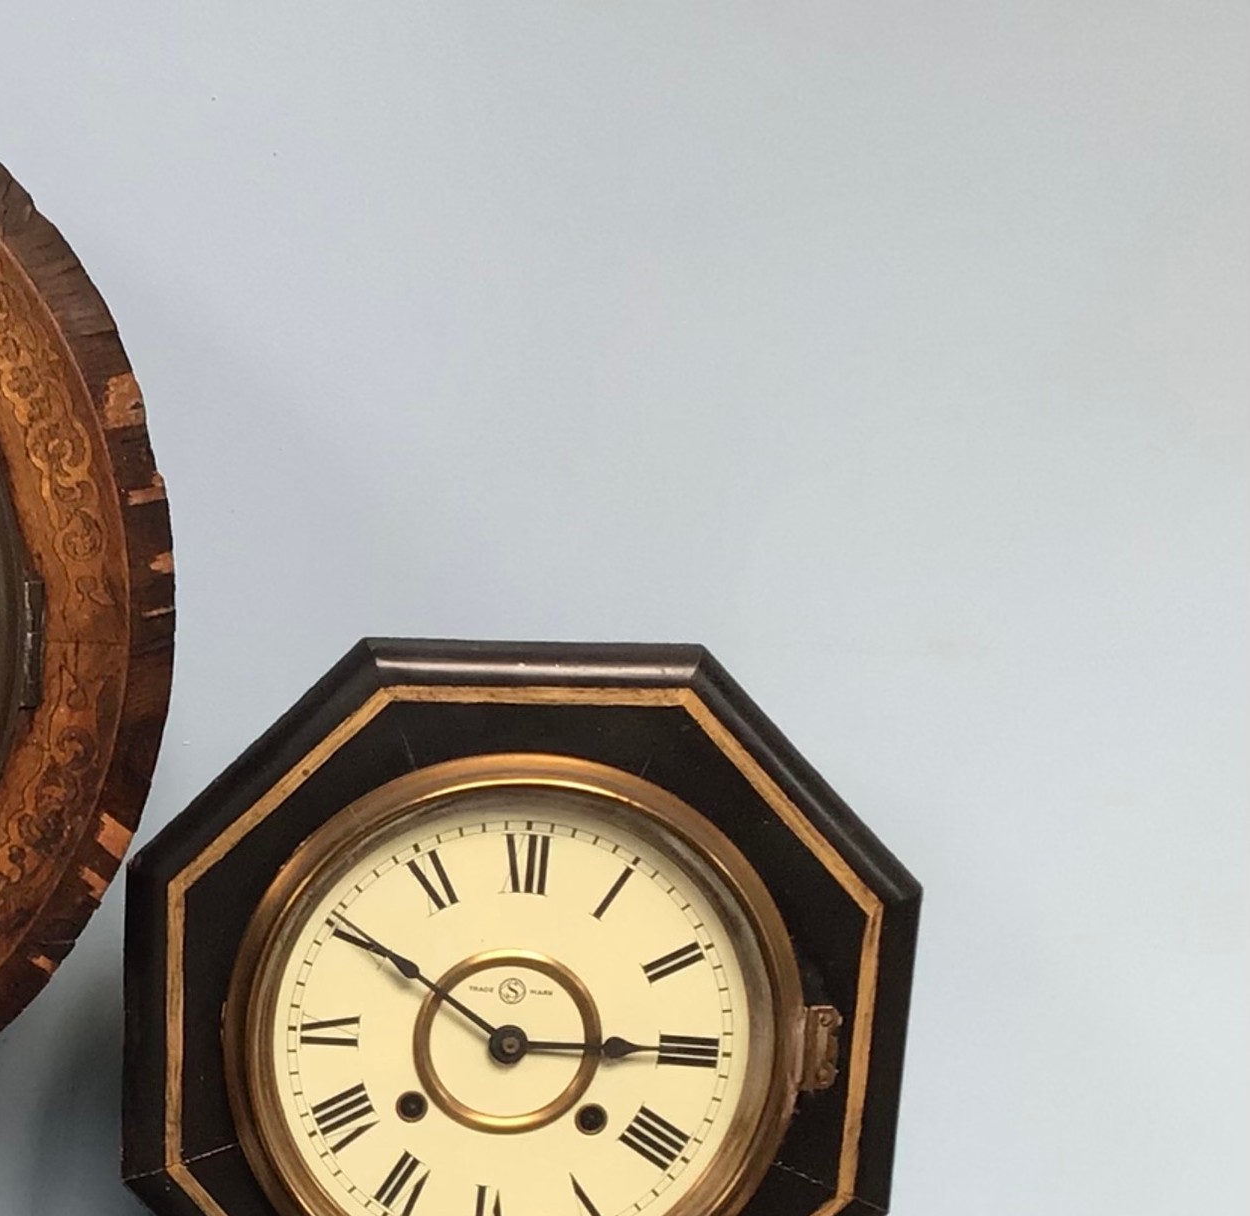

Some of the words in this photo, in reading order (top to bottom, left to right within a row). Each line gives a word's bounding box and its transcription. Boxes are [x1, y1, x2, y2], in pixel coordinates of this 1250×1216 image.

[406, 848, 461, 917] XI
[498, 833, 553, 896] XII
[589, 864, 636, 922] I
[641, 940, 708, 985] II
[299, 1013, 362, 1048] IX
[655, 1032, 720, 1069] III
[310, 1081, 381, 1154] VIII
[617, 1101, 692, 1173] IIII
